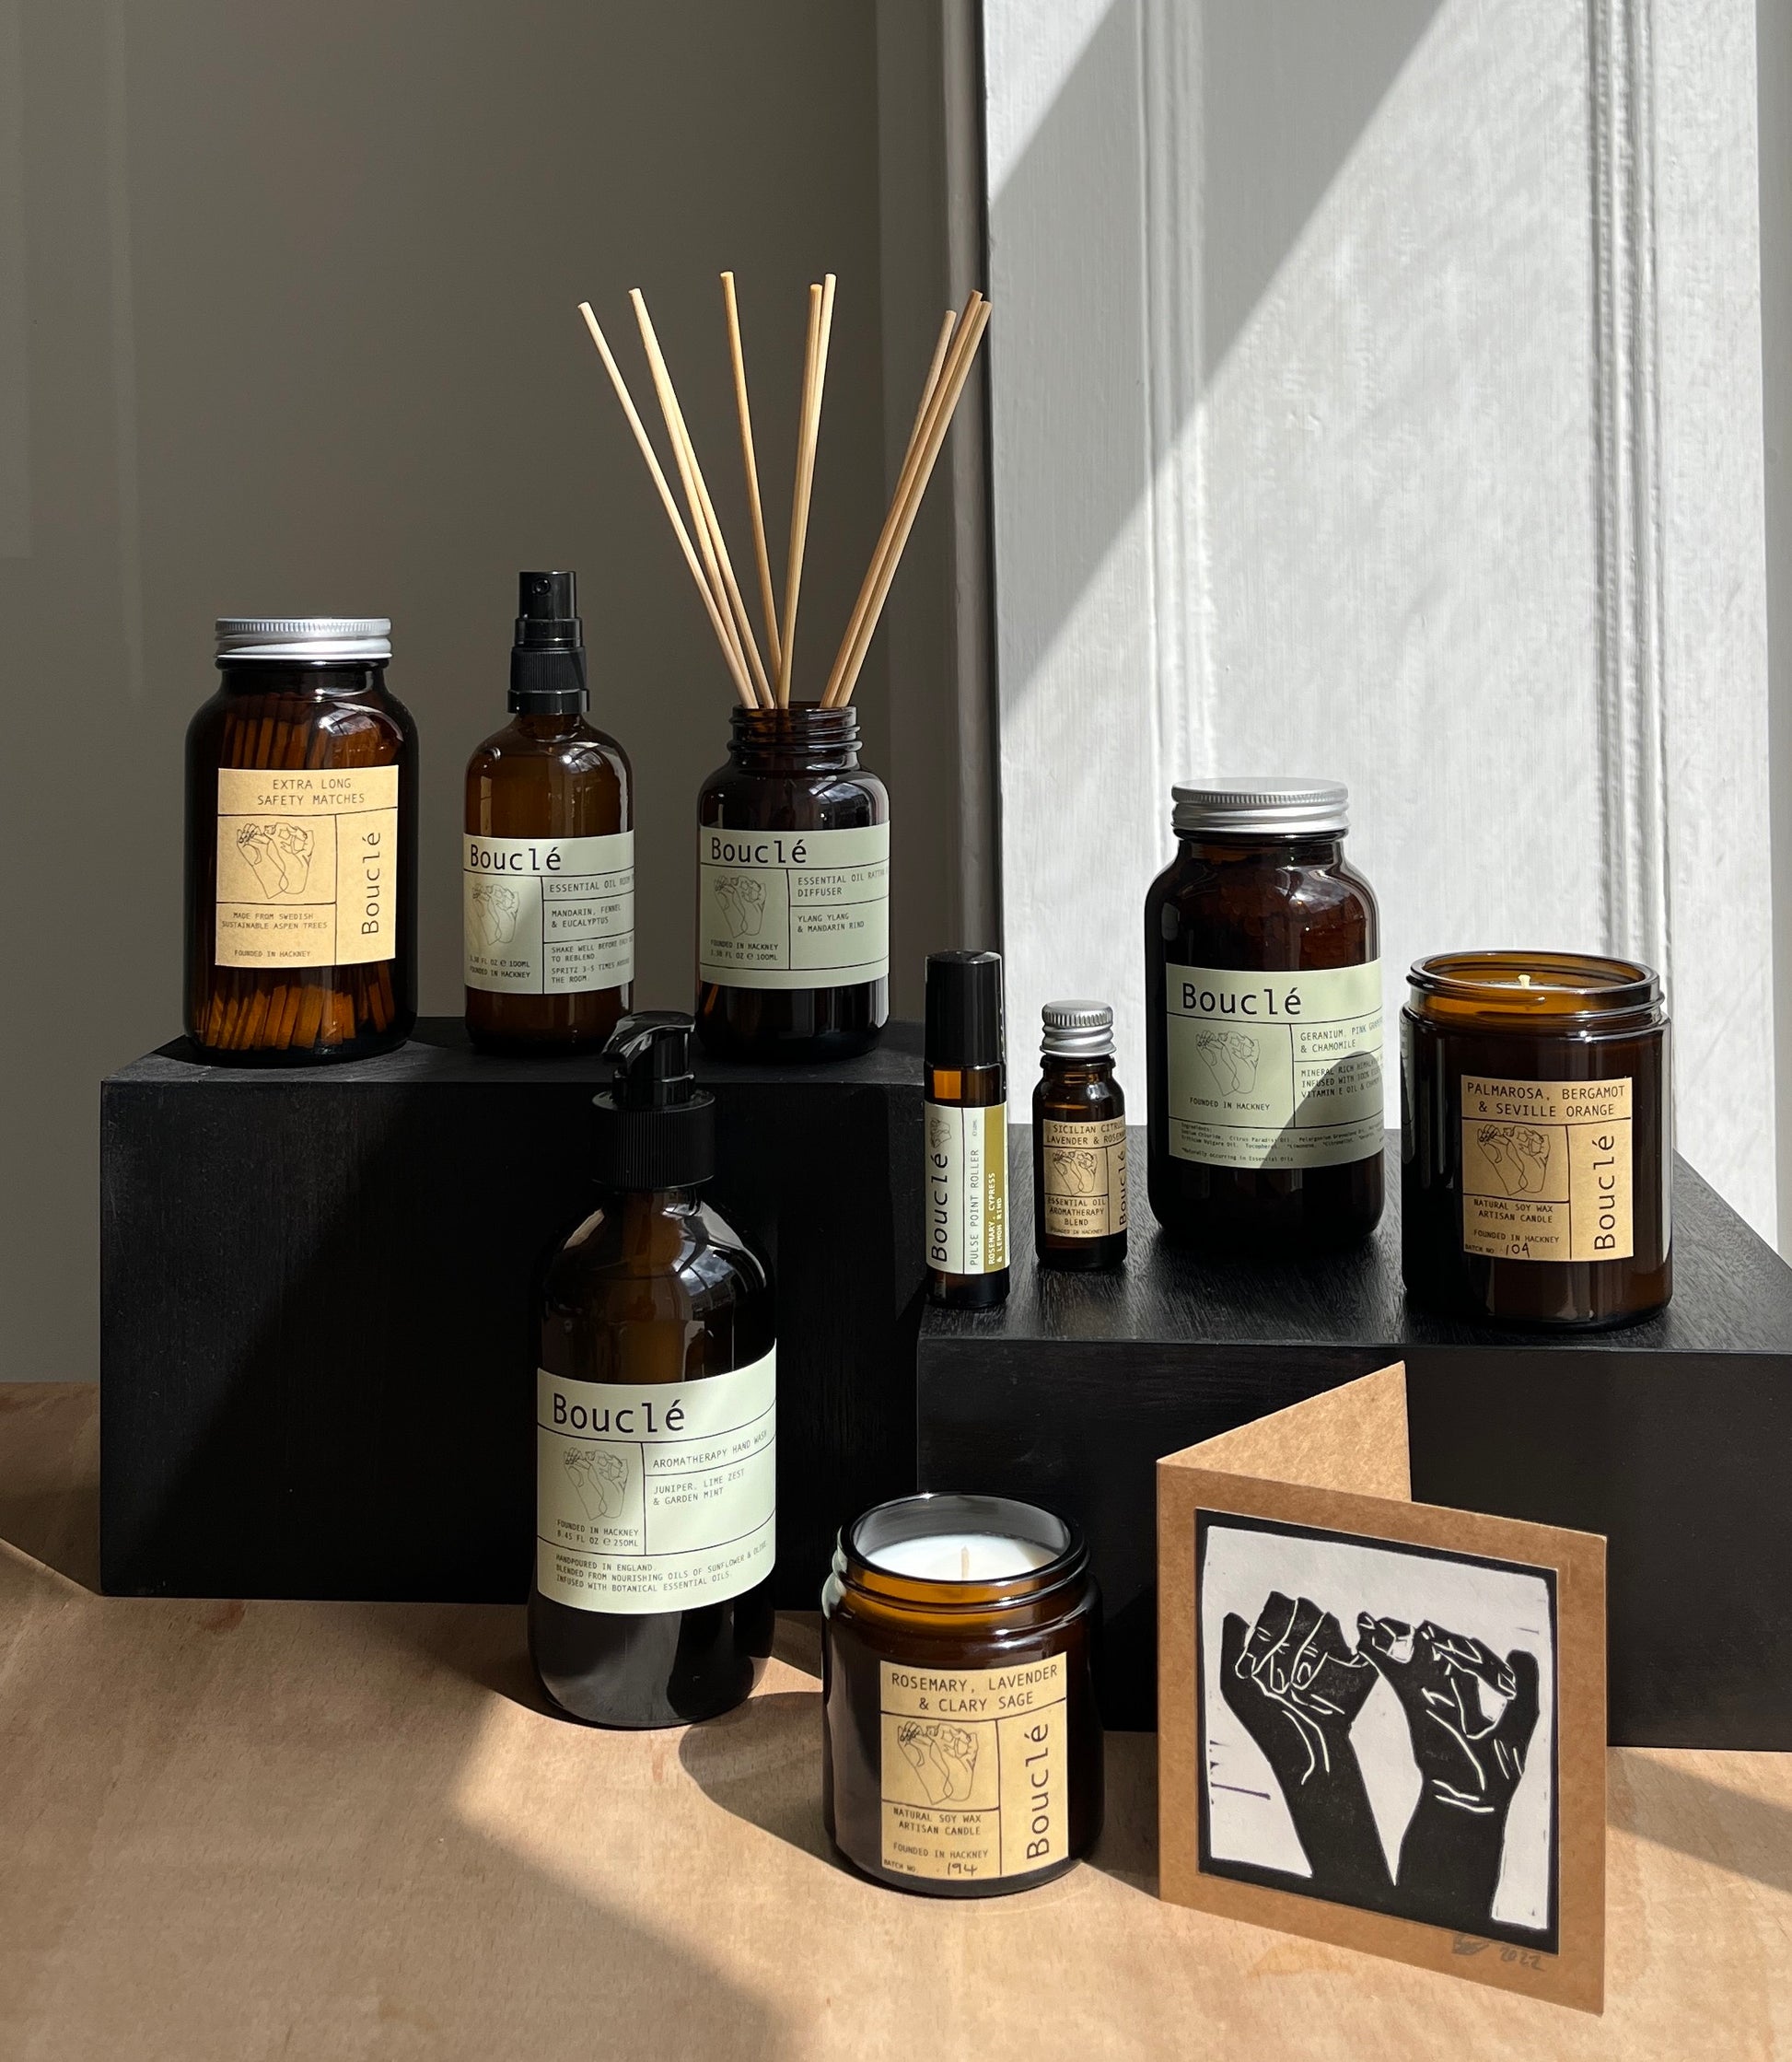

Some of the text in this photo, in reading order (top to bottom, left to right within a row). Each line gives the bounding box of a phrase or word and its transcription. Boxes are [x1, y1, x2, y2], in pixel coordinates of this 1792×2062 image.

[273, 777, 352, 790] EXTRA LONG
[257, 793, 365, 806] SAFETY MATCHES
[470, 844, 562, 871] Bouclé
[711, 837, 807, 864] Bouclé
[361, 832, 380, 935] Bouclé
[549, 880, 616, 892] ESSENTIAL OIL
[797, 873, 865, 886] ESSENTIAL OIL
[797, 887, 843, 897] DIFFUSER
[552, 908, 596, 917] MANDARIN,
[797, 913, 850, 923] YLANG YLANG
[222, 921, 269, 930] SUSTAINABLE
[303, 921, 328, 929] TREES
[551, 916, 609, 928] & EUCALYPTUS
[808, 923, 845, 933] MANDARIN
[849, 920, 865, 929] RIND
[598, 940, 618, 949] BEFORE
[279, 949, 311, 958] HACKNEY
[599, 961, 615, 971] TIMES
[1181, 982, 1302, 1016] Bouclé
[1351, 1024, 1367, 1035] PINK
[1300, 1039, 1356, 1054] & CHAMOMILE
[1301, 1065, 1354, 1078] MINERAL RICH
[1302, 1075, 1355, 1088] INFUSED WITH
[1301, 1089, 1335, 1099] VITAMIN
[1346, 1085, 1357, 1093] OIL
[1467, 1082, 1625, 1101] PALMAROSA, BERGAMOT
[1189, 1097, 1271, 1112] FOUNDED IN HACKNEY
[1478, 1101, 1614, 1117] & SEVILLE ORANGE
[1053, 1124, 1096, 1135] SICILIAN
[1046, 1136, 1088, 1145] LAVENDER
[1093, 1136, 1100, 1145] &
[1591, 1135, 1616, 1250] Bouclé
[930, 1153, 948, 1263] Bouclé
[970, 1149, 979, 1266] PULSE POINT ROLLER
[1047, 1198, 1088, 1206] ESSENTIAL
[1473, 1198, 1508, 1210] NATURAL
[1536, 1205, 1553, 1213] WAX
[1049, 1206, 1104, 1216] AROMATHERAPY
[1478, 1210, 1553, 1223] ARTISAN CANDLE
[1064, 1217, 1088, 1226] BLEND
[1473, 1229, 1560, 1244] FOUNDED IN HACKNEY
[553, 1392, 685, 1434] Bouclé
[653, 1429, 767, 1469] AROMATHERAPY HAND WASH
[703, 1475, 723, 1487] LIME
[727, 1468, 745, 1482] ZEST
[653, 1487, 724, 1506] & GARDEN MINT
[557, 1519, 585, 1532] FOUNDED
[576, 1534, 585, 1543] FL
[613, 1539, 639, 1547] 250ML
[556, 1554, 598, 1569] HANDPOURED
[602, 1563, 611, 1571] IN
[556, 1554, 745, 1582] BLENDED FROM NOURISHING OILS OF SUNFLOWER
[556, 1575, 708, 1592] INFUSED WITH BOTANICAL ESSENTIAL
[891, 1664, 1057, 1694] ROSEMARY, LAVENDER
[919, 1691, 1033, 1713] & CLARY SAGE
[1024, 1723, 1050, 1859] Bouclé
[893, 1808, 982, 1823] NATURAL SOY WAX
[898, 1821, 981, 1835] ARTISAN CANDLE
[893, 1842, 989, 1858] FOUNDED IN HACKNEY
[947, 1862, 978, 1875] 194
